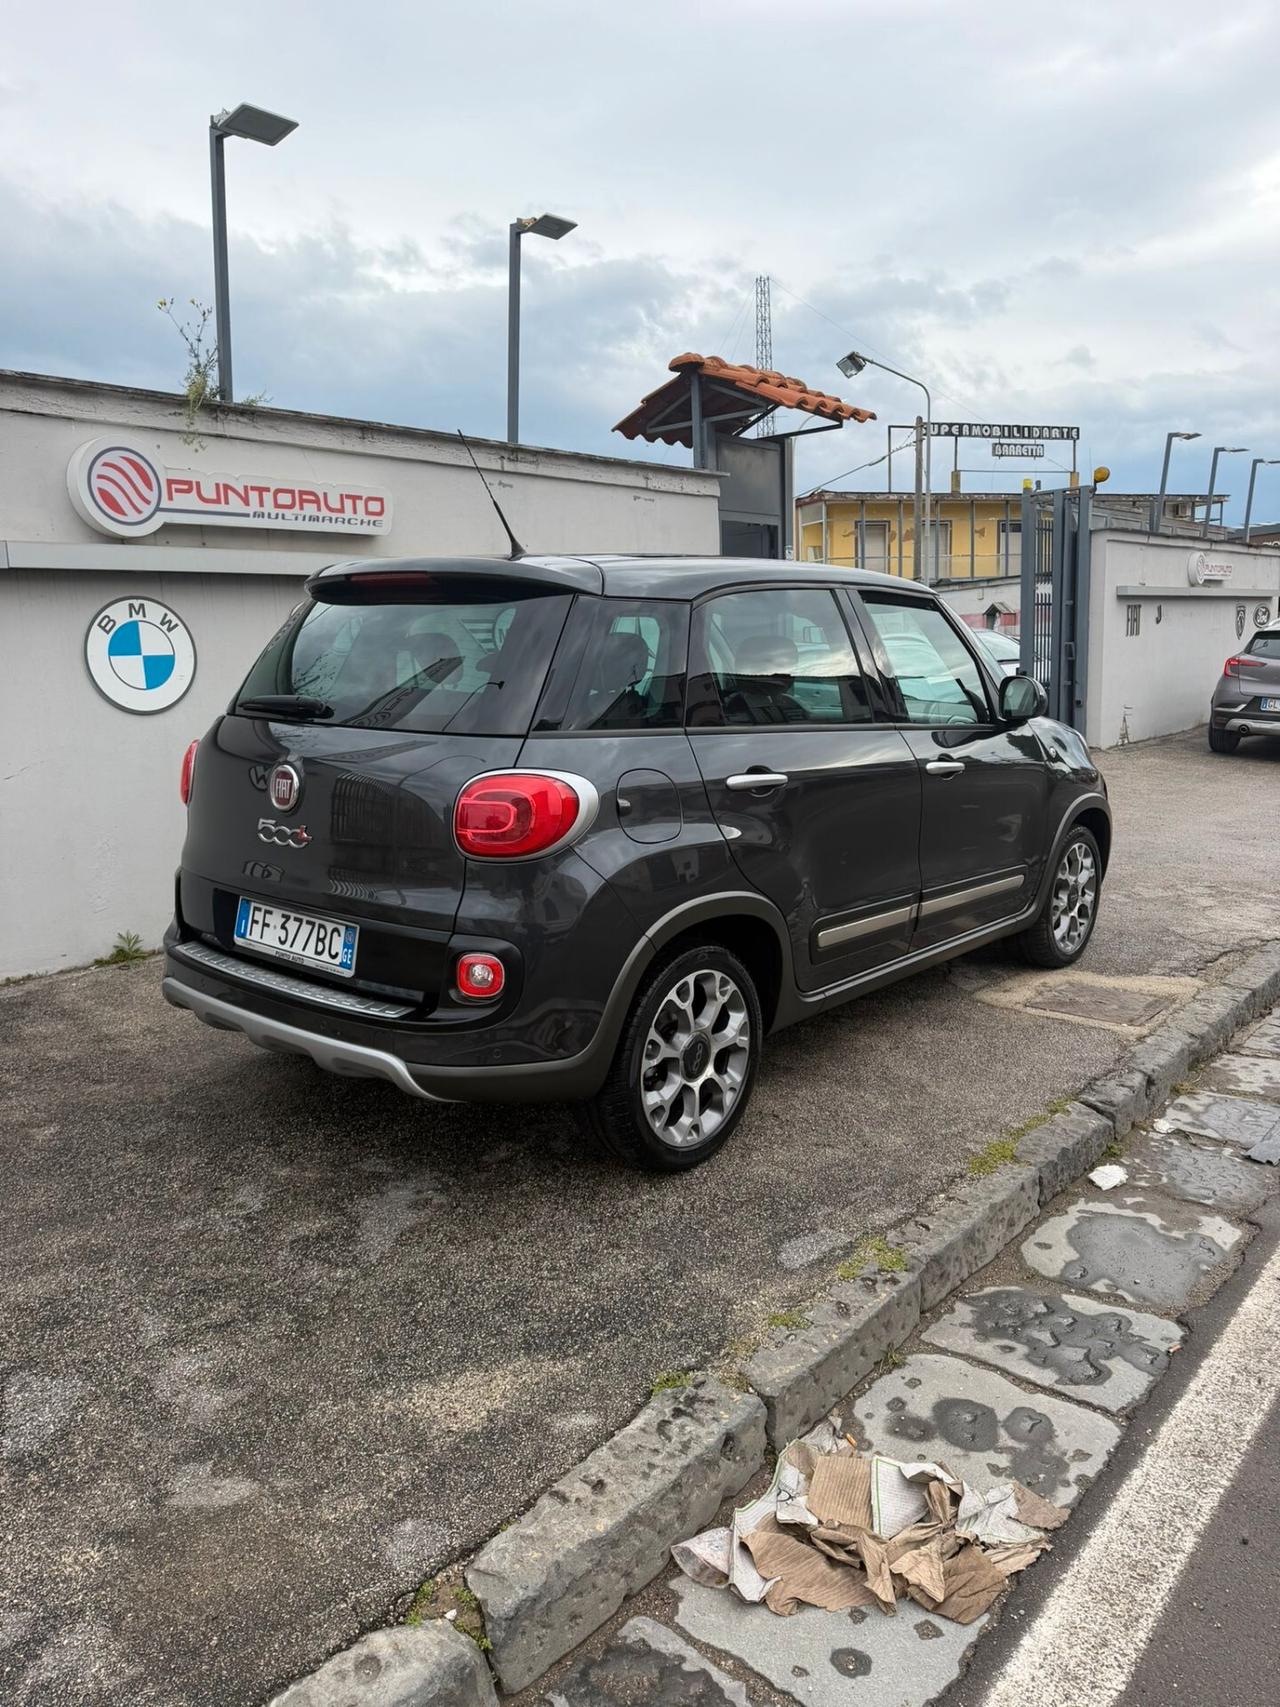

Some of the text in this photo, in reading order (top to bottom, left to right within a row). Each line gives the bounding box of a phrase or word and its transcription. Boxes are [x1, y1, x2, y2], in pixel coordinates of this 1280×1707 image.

[995, 444, 1043, 456] BARRETTA
[166, 478, 385, 517] PUNTOAUTO
[252, 510, 384, 528] MULTIMARCHE
[97, 602, 179, 635] BMW
[275, 778, 292, 799] FIAT
[342, 948, 353, 964] GE
